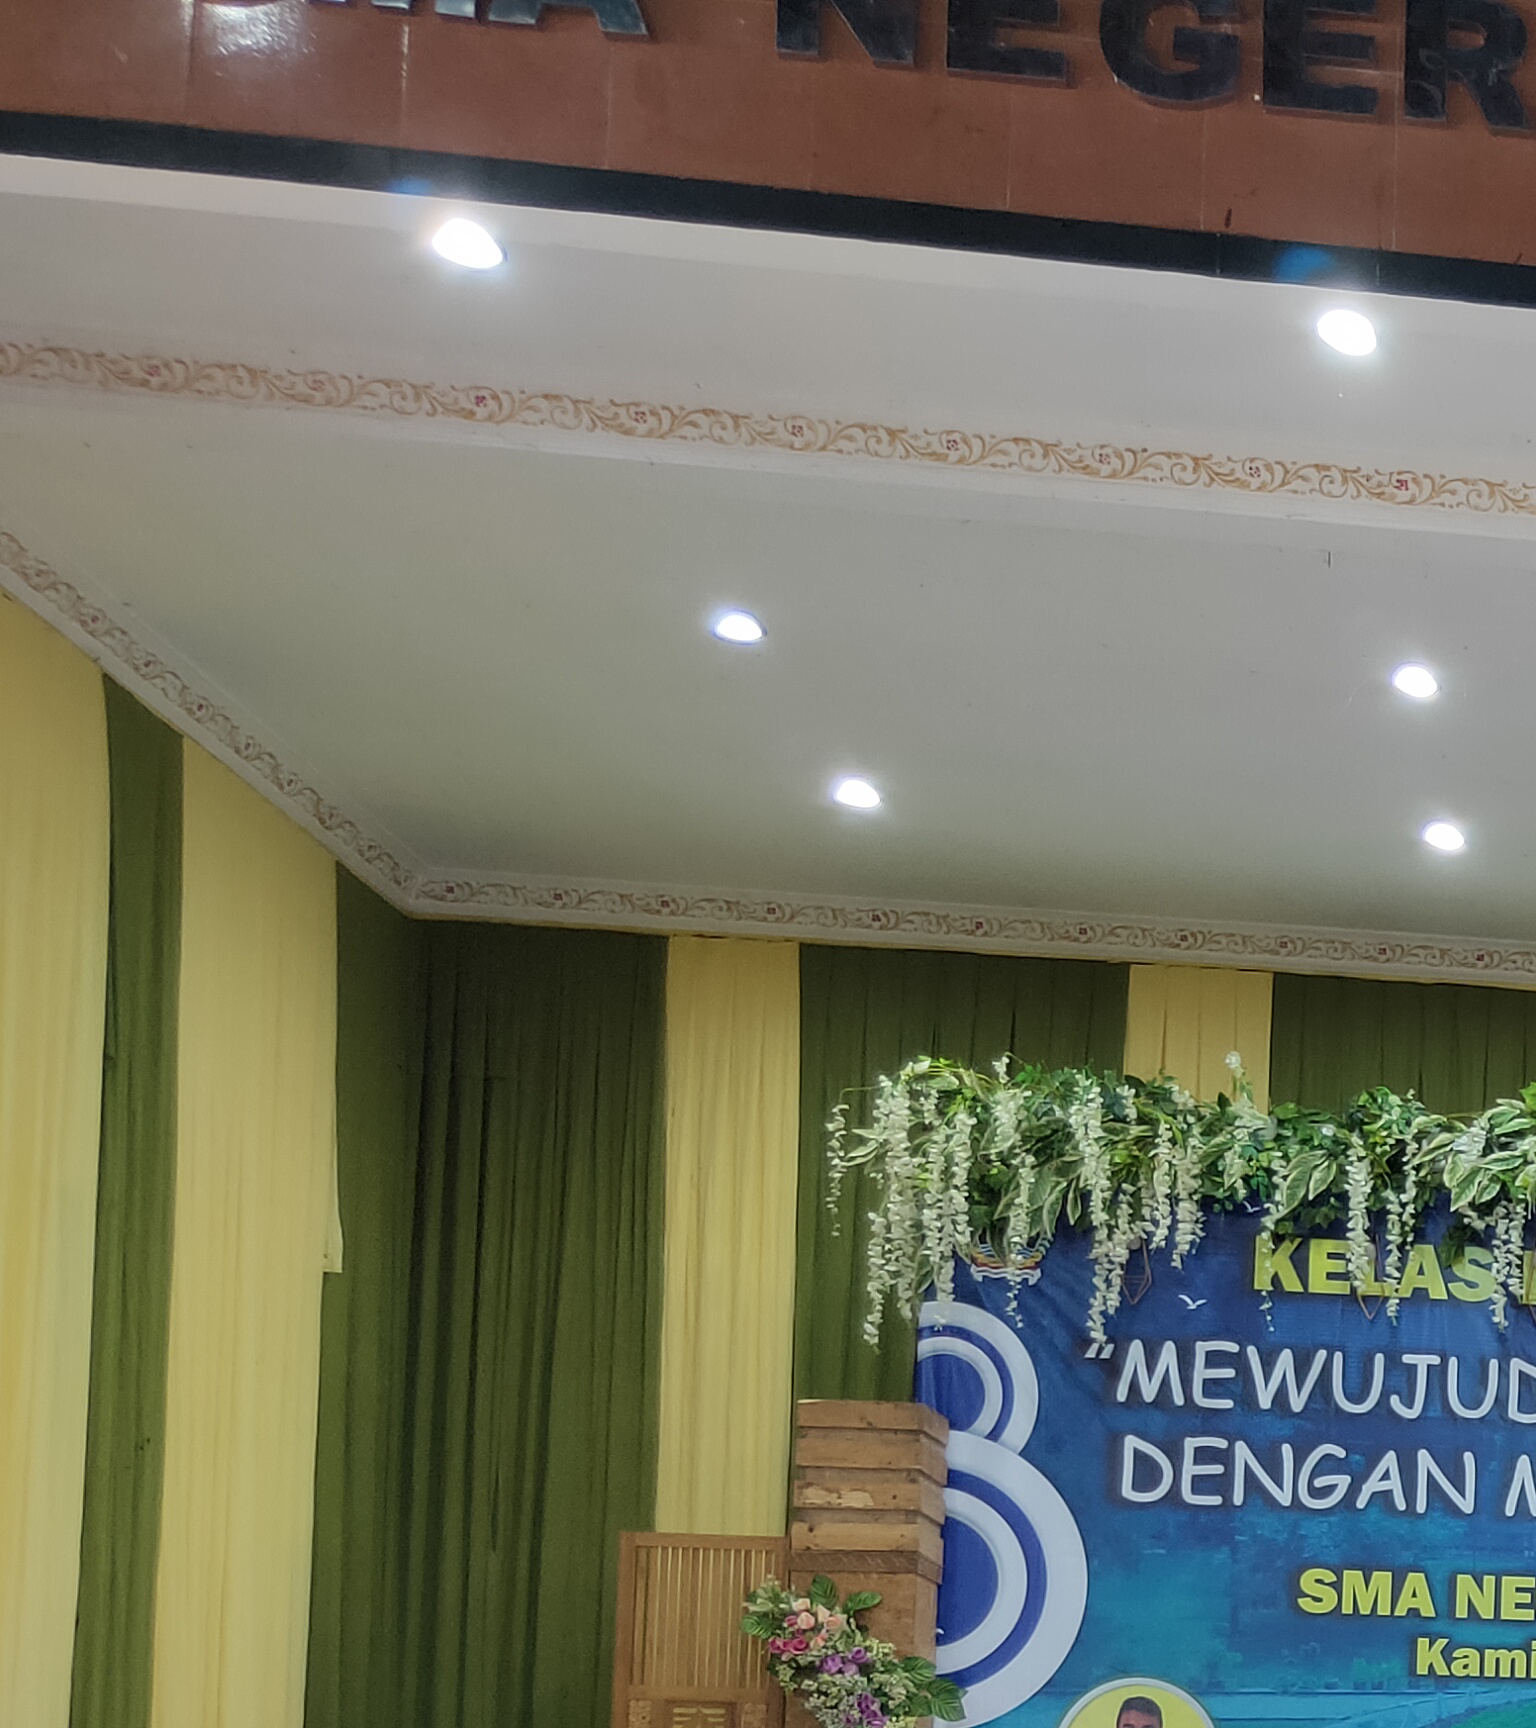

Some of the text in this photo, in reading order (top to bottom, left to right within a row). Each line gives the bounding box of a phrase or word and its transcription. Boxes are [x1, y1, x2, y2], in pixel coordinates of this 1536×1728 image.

[1253, 1235, 1498, 1302] KELAS
[1121, 1434, 1475, 1514] DENGAN
[1297, 1567, 1436, 1618] SMA
